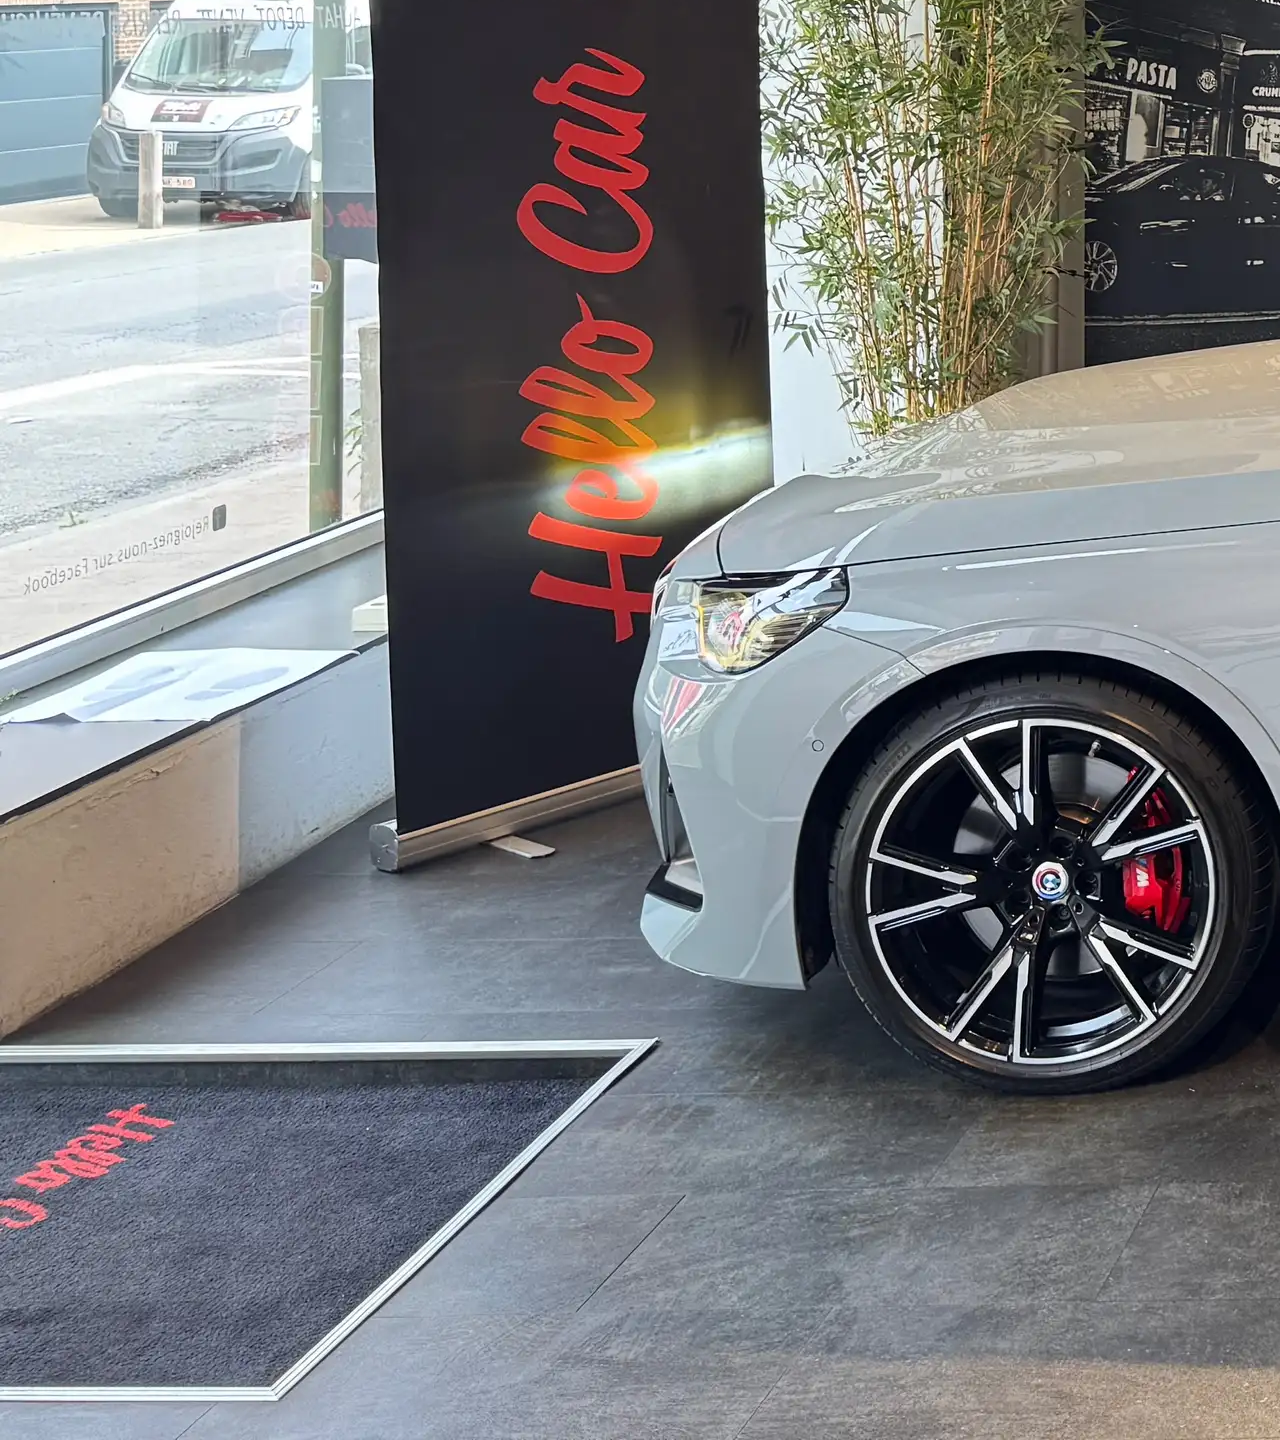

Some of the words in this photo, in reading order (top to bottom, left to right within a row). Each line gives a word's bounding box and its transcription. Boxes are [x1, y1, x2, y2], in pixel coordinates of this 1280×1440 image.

[517, 47, 655, 275] Car
[1127, 58, 1177, 90] PASTA
[519, 294, 663, 643] Hello
